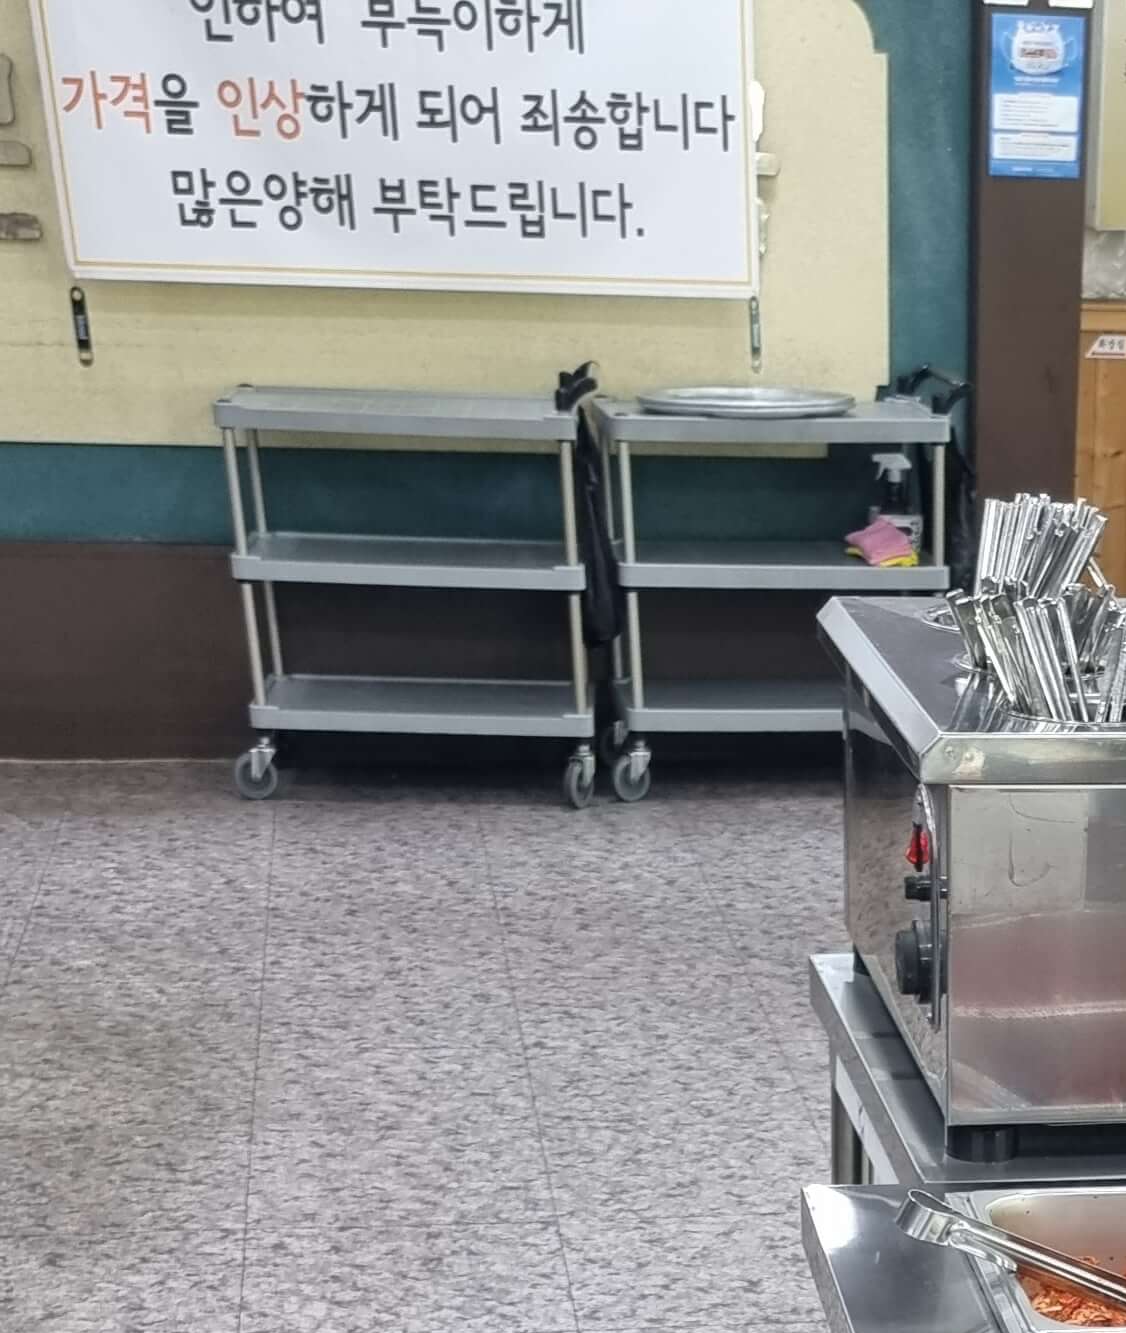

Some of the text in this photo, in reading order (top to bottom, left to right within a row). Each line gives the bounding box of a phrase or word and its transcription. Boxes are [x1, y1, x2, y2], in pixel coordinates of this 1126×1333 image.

[190, 0, 585, 55] 인하여 부득이하게
[61, 70, 736, 152] 가격을 인상하게 되어 죄송합니다
[372, 177, 646, 240] 부탁드립니다.
